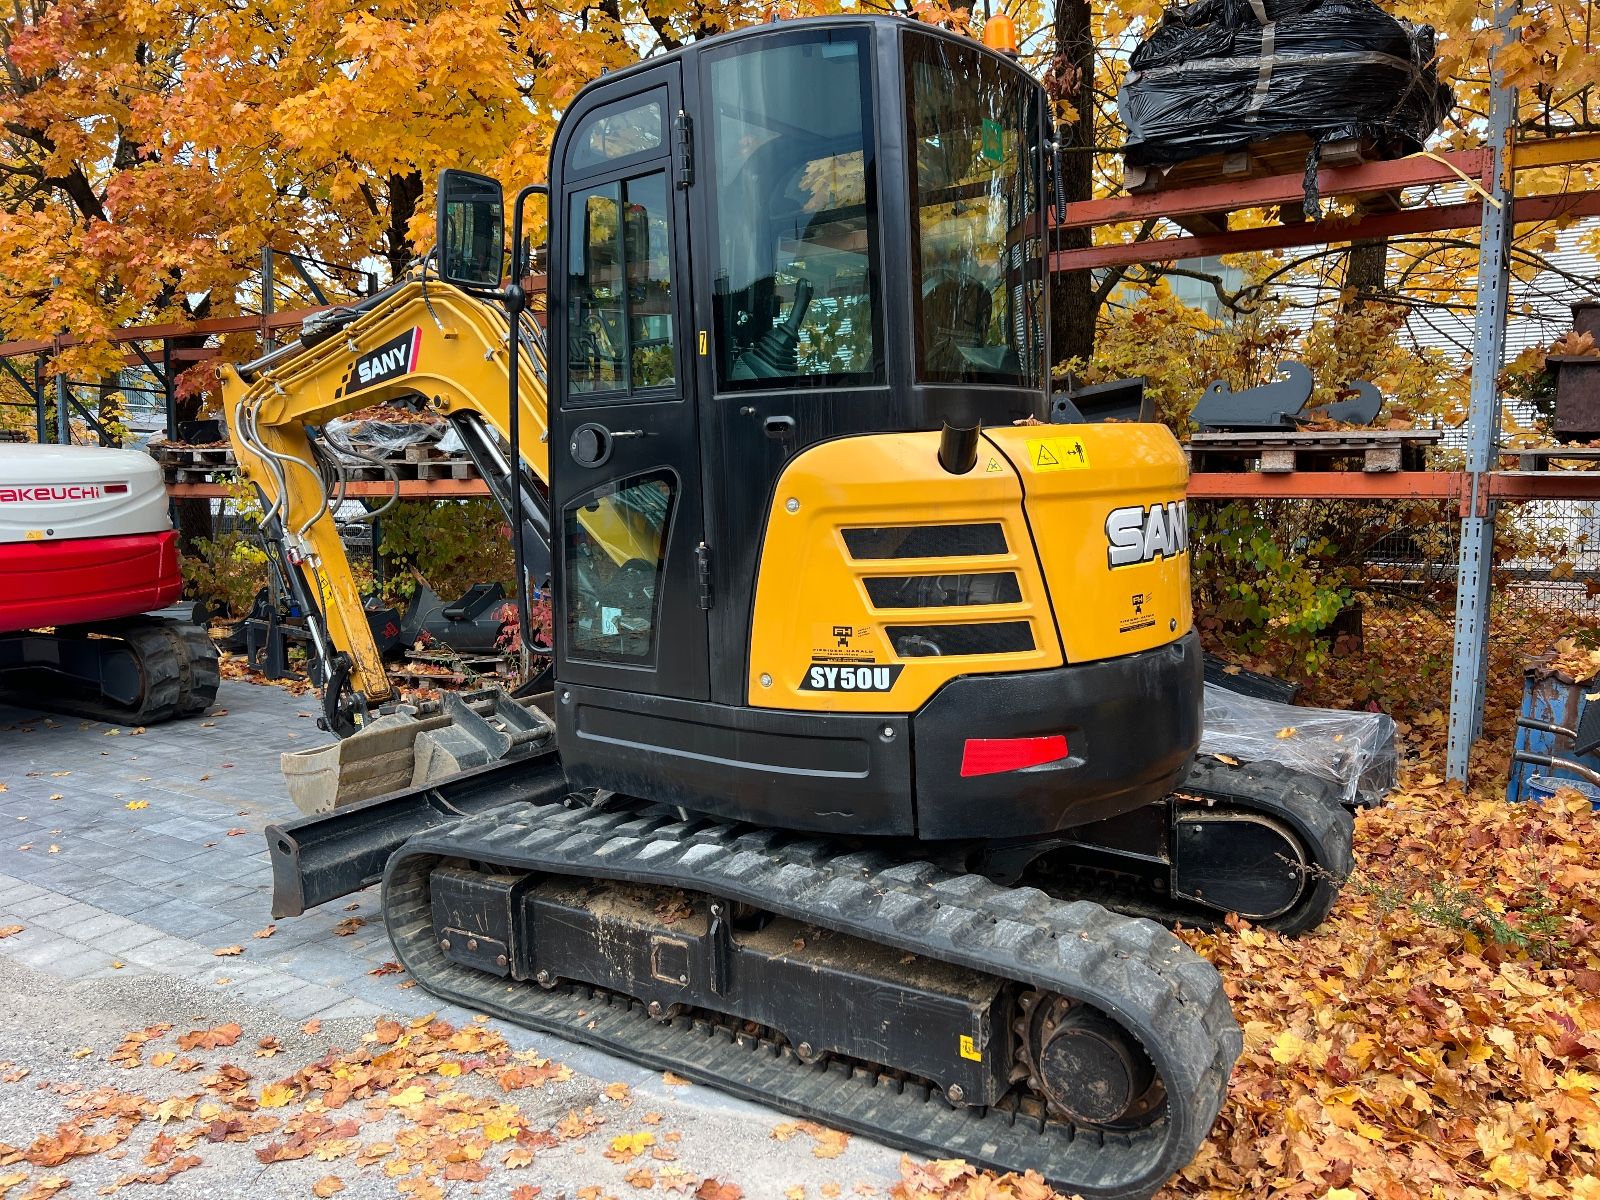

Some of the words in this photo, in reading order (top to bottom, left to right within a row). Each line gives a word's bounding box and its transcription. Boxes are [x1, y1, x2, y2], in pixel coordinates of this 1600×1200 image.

[358, 343, 407, 384] SANY
[834, 627, 852, 636] FH
[810, 666, 890, 690] SY50U
